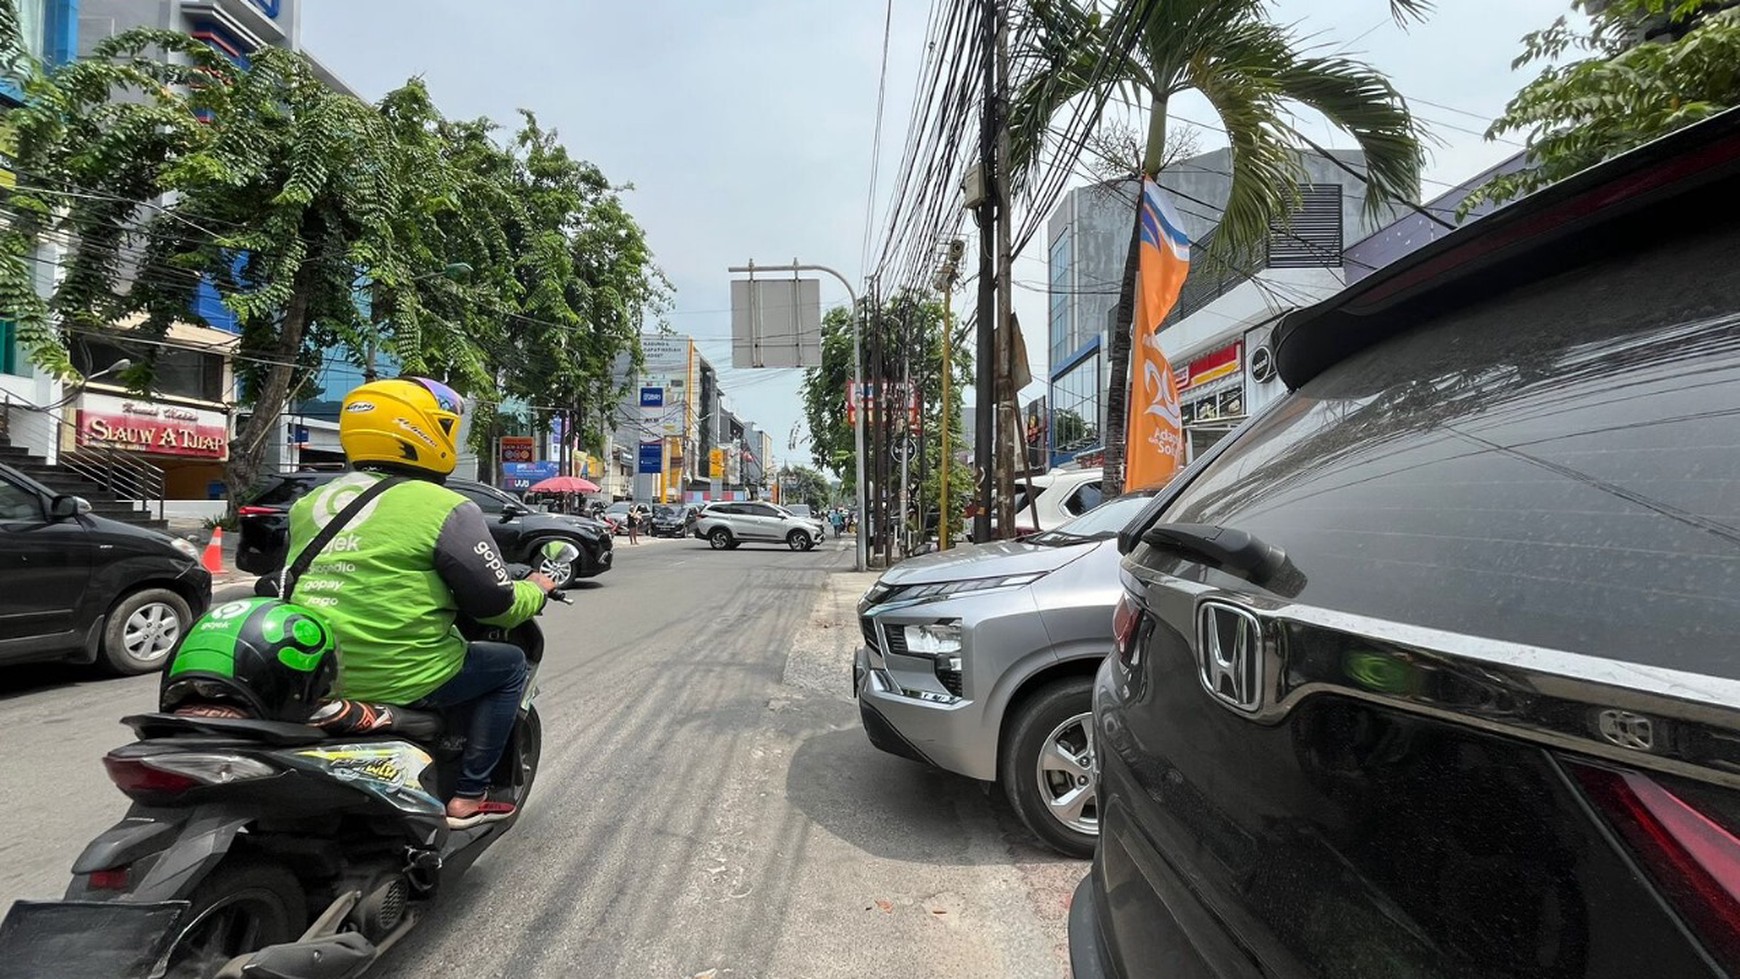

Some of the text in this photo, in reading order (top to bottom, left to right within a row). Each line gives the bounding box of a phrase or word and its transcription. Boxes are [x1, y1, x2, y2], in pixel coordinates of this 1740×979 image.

[158, 428, 177, 447] A
[473, 541, 512, 586] gopay
[303, 580, 345, 592] gopay
